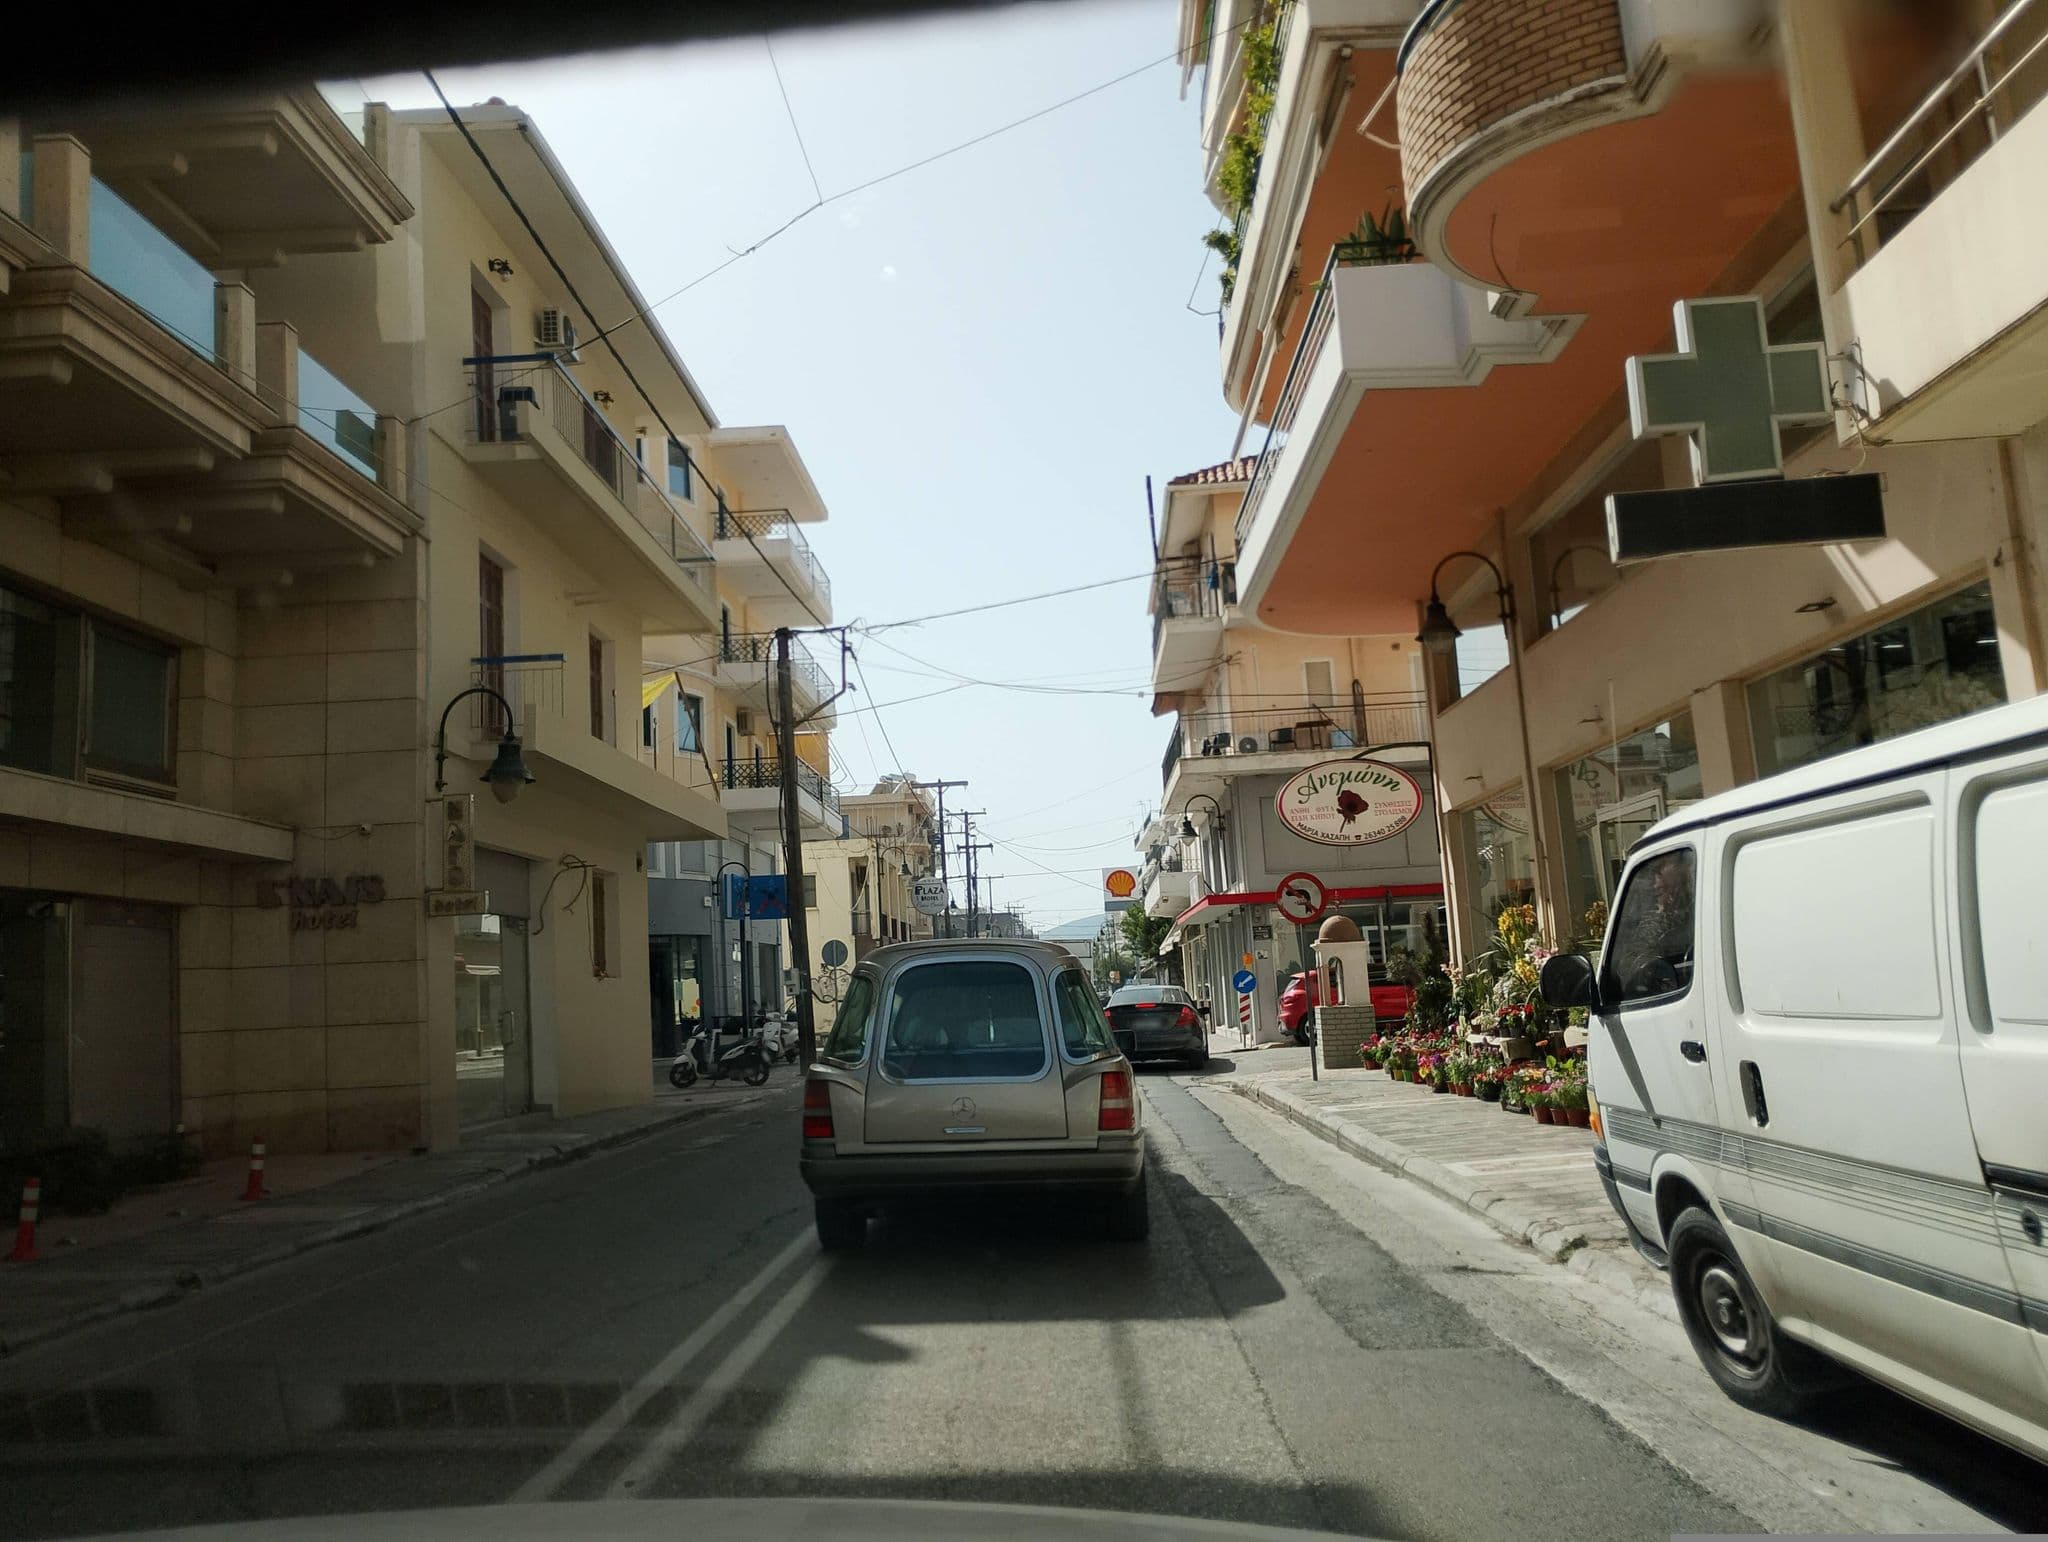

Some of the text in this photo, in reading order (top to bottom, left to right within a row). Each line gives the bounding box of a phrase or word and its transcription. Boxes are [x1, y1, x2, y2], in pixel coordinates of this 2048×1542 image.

[1297, 765, 1401, 804] Ανεμώνη
[1363, 827, 1386, 840] 26340
[914, 885, 945, 896] PLAZA
